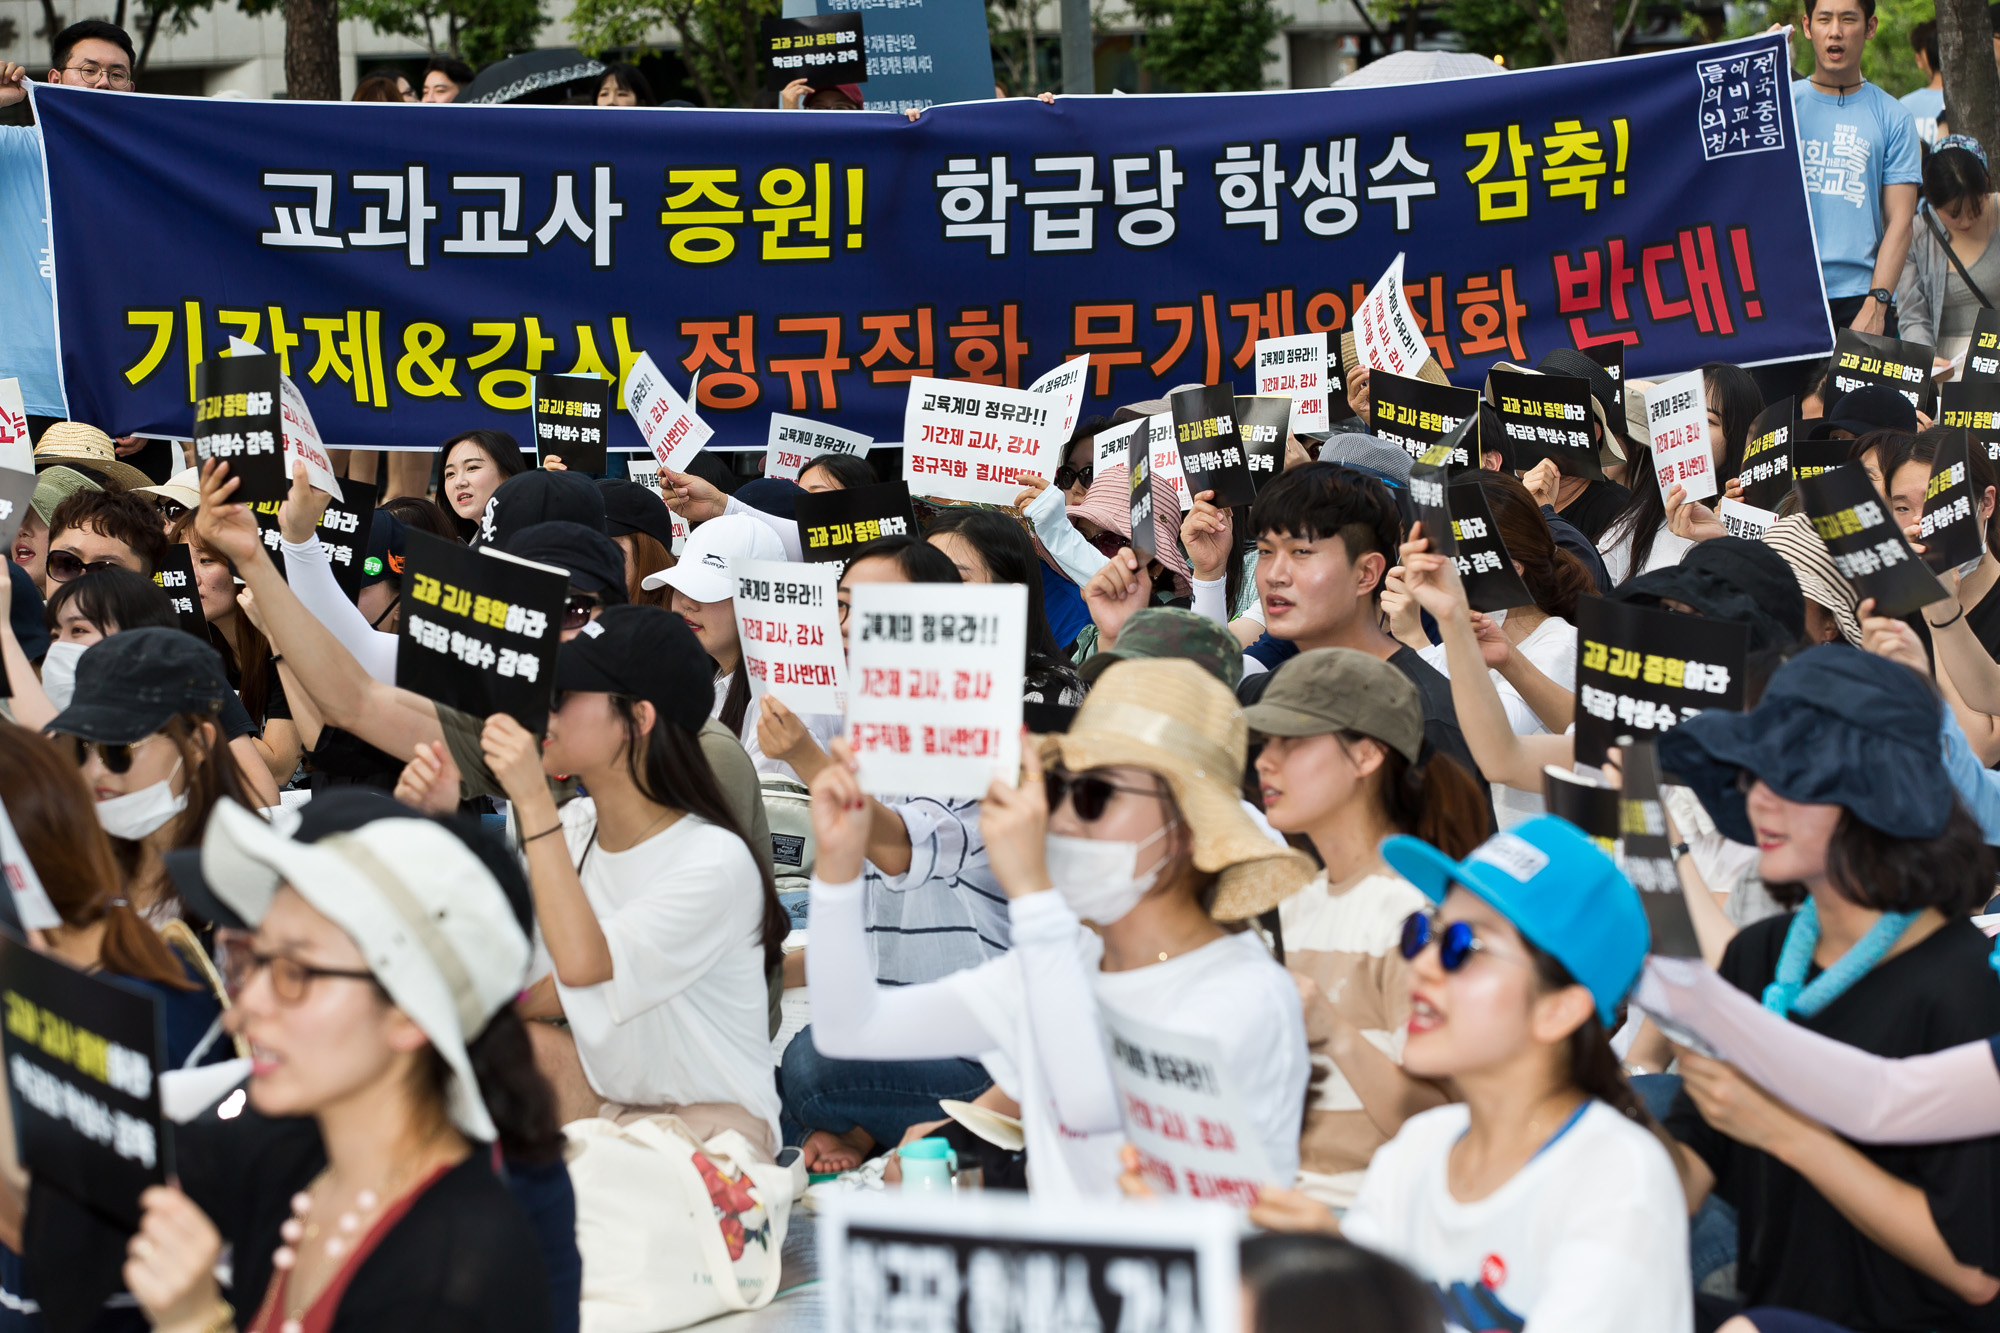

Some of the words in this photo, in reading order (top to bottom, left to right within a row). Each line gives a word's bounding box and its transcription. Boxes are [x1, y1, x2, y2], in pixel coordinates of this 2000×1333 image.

[771, 37, 792, 50] 교과
[793, 35, 814, 48] 교사
[816, 31, 856, 46] 증원하라
[804, 52, 835, 66] 학생수
[837, 49, 858, 63] 감축
[1700, 63, 1728, 154] 들의외침
[1727, 57, 1751, 149] 예비교사
[1751, 52, 1780, 147] 전국중등
[261, 166, 623, 267] 교과교사
[661, 162, 863, 264] 증원!
[936, 148, 1184, 255] 학급당
[1215, 135, 1437, 241] 학생수
[1464, 118, 1629, 221] 감축!
[680, 304, 1028, 410] 정규직화
[1553, 225, 1763, 349] 반대!
[1378, 323, 1392, 353] 교사,
[1393, 312, 1418, 360] 정유라!!
[1977, 331, 1997, 349] 교과
[1261, 348, 1286, 368] 교육계의
[1287, 346, 1318, 364] 정유라!!
[1838, 352, 1860, 369] 교과
[1860, 356, 1882, 375] 교사
[1883, 361, 1924, 384] 증원하라
[1971, 355, 2000, 375] 학급당
[1262, 376, 1280, 393] 기간제
[1280, 374, 1299, 391] 교사,
[1300, 372, 1318, 389] 강사
[223, 391, 273, 417] 증원하라
[550, 397, 565, 416] 교사
[565, 401, 602, 419] 증원하라
[921, 393, 981, 417] 교육계의
[984, 400, 1048, 427] 정유라!!
[1377, 399, 1396, 421] 교과
[1397, 405, 1418, 427] 교사
[1501, 396, 1521, 414] 교과
[1522, 399, 1543, 417] 교사
[1543, 401, 1586, 422] 증원하라
[554, 424, 580, 442] 학생수
[581, 426, 601, 444] 감축
[779, 426, 813, 446] 교육계의
[814, 433, 856, 456] 정유라!!
[921, 424, 964, 447] 기간제
[967, 430, 1003, 455] 교사,
[1007, 435, 1041, 457] 강사
[1190, 421, 1203, 441] 교사
[1203, 414, 1233, 438] 증원하라
[1505, 422, 1537, 442] 학급당
[1537, 425, 1568, 446] 학생수
[1568, 429, 1591, 449] 감축
[1669, 427, 1685, 448] 교사,
[1685, 421, 1700, 444] 강사
[1762, 425, 1789, 452] 증원하라
[246, 429, 275, 456] 감축
[1405, 437, 1434, 458] 학생
[777, 451, 801, 468] 기간제
[804, 456, 816, 468] 교
[911, 455, 968, 479] 정규직화
[1154, 450, 1178, 468] 강사
[1199, 449, 1222, 473] 학생수
[1222, 446, 1241, 469] 감축
[1248, 453, 1275, 473] 감축
[1678, 454, 1709, 480] 결사반대!
[1753, 461, 1774, 482] 학생수
[1774, 454, 1789, 475] 감축
[1939, 460, 1966, 492] 증원하라
[316, 508, 359, 534] 하라
[1933, 504, 1954, 530] 학생수
[1953, 495, 1971, 521] 감축
[807, 523, 829, 548] 교과
[830, 523, 853, 546] 교사
[854, 515, 907, 543] 증원하라
[1470, 550, 1503, 575] 감축
[411, 572, 442, 607] 교과
[440, 584, 473, 618] 교사
[473, 594, 548, 640] 증원하라
[773, 581, 823, 608] 정유라!!
[765, 622, 793, 649] 교사,
[796, 623, 824, 648] 강사
[920, 612, 1000, 646] 정유라!!
[408, 614, 451, 655] 학급당
[449, 630, 496, 670] 학생수
[496, 647, 540, 683] 감축
[773, 661, 837, 688] 결사반대!
[1608, 646, 1643, 680] 교사
[1643, 653, 1732, 695] 증원하라
[952, 670, 995, 701] 강사
[1617, 694, 1677, 733] 학생수
